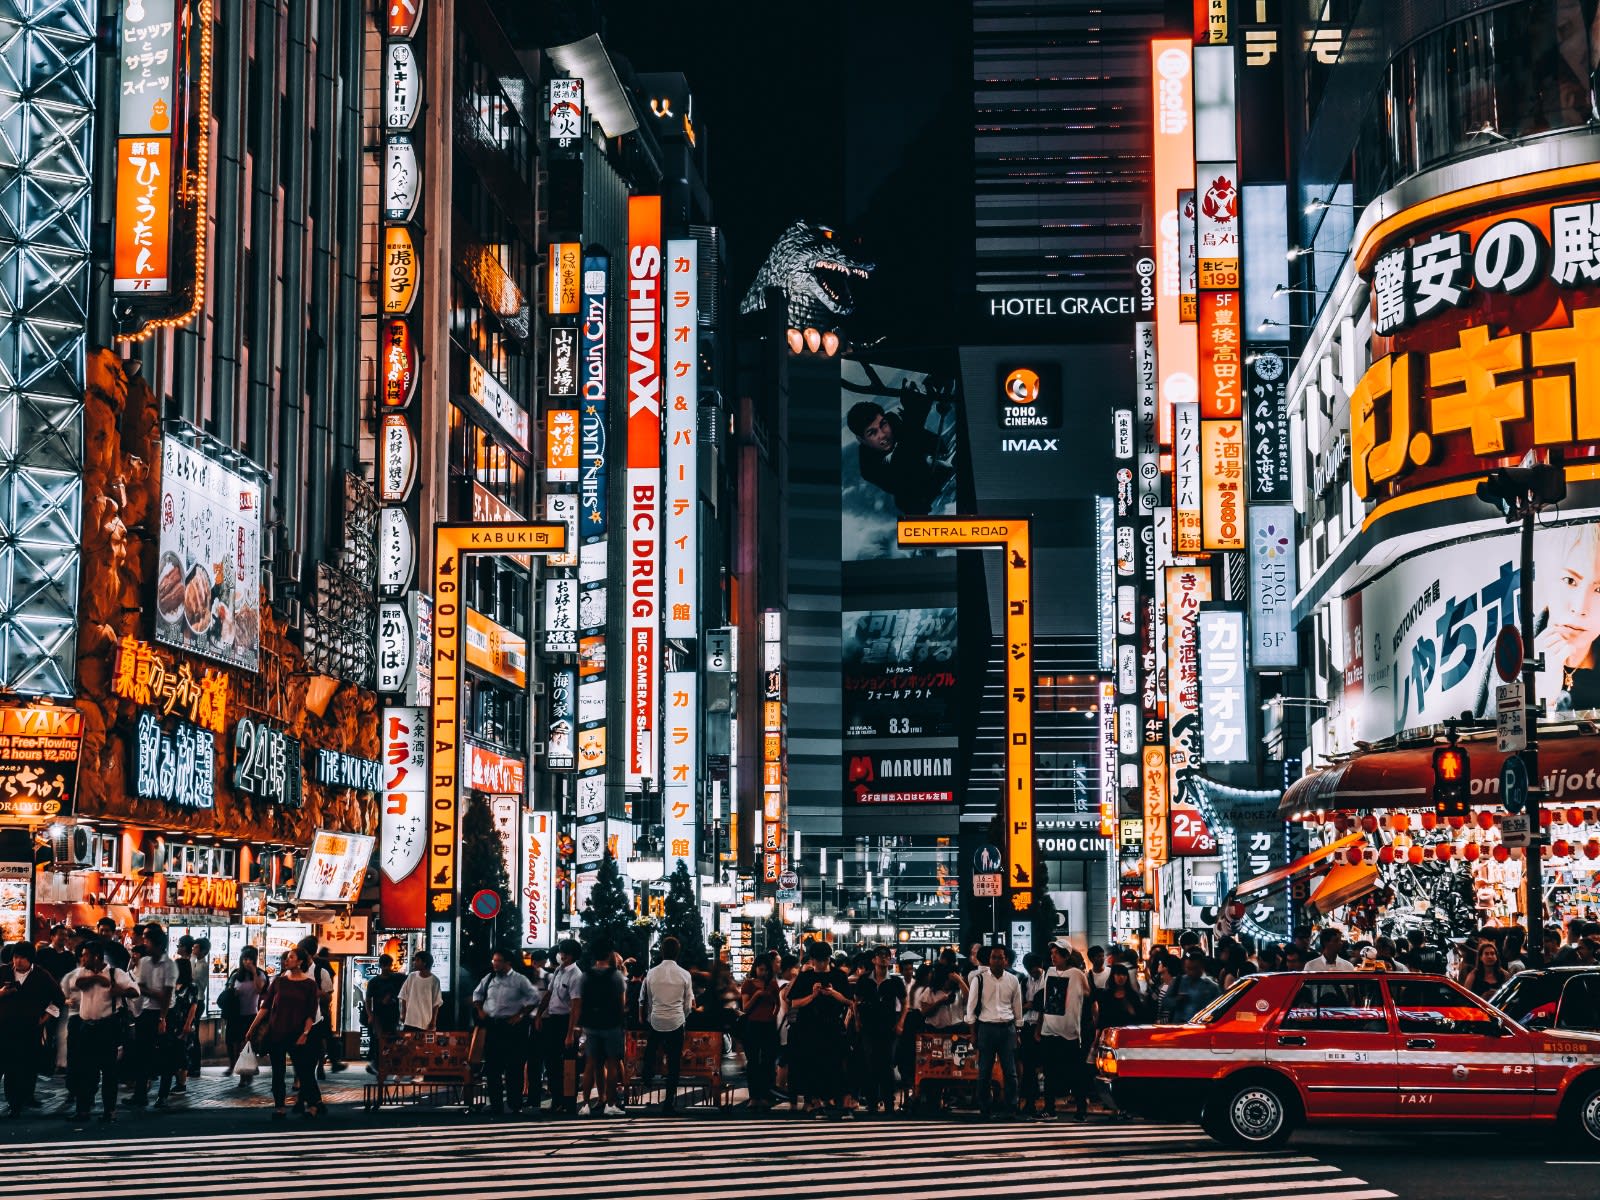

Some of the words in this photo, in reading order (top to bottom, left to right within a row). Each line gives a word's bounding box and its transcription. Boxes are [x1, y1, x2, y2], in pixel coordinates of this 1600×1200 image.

[391, 26, 409, 34] 7F
[125, 49, 169, 70] サラダ
[123, 76, 170, 95] スイーツ
[389, 113, 410, 126] 6F
[131, 142, 160, 155] 新宿
[559, 138, 572, 148] 8F
[128, 156, 162, 275] ひょうたん
[391, 209, 405, 218] 5F
[134, 279, 152, 291] 7F
[389, 250, 412, 293] 虎の子
[1136, 257, 1155, 311] Booth
[1208, 272, 1237, 286] 199
[386, 300, 403, 310] 4F
[991, 298, 1056, 315] HOTEL
[1060, 297, 1135, 315] GRACE
[1216, 294, 1232, 307] 5F
[629, 245, 661, 419] SHIDAX
[1142, 328, 1155, 391] ネットカフェ
[1211, 309, 1239, 416] 豊後高田どり
[472, 366, 482, 397] 3F
[1004, 406, 1036, 417] TOHO
[1004, 416, 1048, 426] CINEMAS
[1002, 439, 1058, 452] IMAX
[1119, 419, 1129, 454] 東京ビル
[1253, 383, 1275, 493] かんかん商店
[388, 428, 403, 491] お好み焼き
[582, 416, 599, 509] SHINJUKU
[1144, 466, 1155, 475] 8F
[1179, 411, 1193, 505] キタノイチバ
[1215, 441, 1242, 480] 酒場
[632, 485, 655, 532] BIC
[1144, 497, 1156, 506] 5F
[1220, 491, 1237, 538] 280
[903, 527, 967, 538] CENTRAL
[971, 526, 1009, 536] ROAD
[388, 526, 402, 581] とらそば
[384, 585, 399, 595] 1F
[632, 540, 654, 618] DRUG
[1261, 564, 1274, 615] STAGE
[1274, 564, 1287, 605] IDOL
[382, 610, 401, 619] 新宿
[555, 581, 571, 629] お好み焼
[381, 619, 402, 669] かっぱ
[637, 631, 648, 653] BIC
[1262, 632, 1287, 648] 5F
[383, 675, 399, 686] B1
[435, 581, 456, 754] GODZILLA
[553, 672, 569, 718] 海の家
[636, 656, 648, 708] CAMERA
[1207, 617, 1242, 756] カラオケ
[15, 710, 81, 736] YAKI
[889, 718, 910, 734] 8.3
[1009, 599, 1028, 835] ゴジラロード
[1145, 719, 1163, 730] 4F
[11, 737, 79, 751] Free-Flowing
[411, 711, 425, 768] 大衆酒場
[1145, 731, 1163, 742] 3F
[2, 750, 10, 760] 2
[11, 749, 42, 760] hours
[138, 711, 215, 808] 飲み放題
[319, 748, 339, 784] THE
[386, 716, 410, 816] トラノコ
[880, 758, 952, 778] MARUHAN
[671, 690, 691, 857] カラオケ館
[44, 802, 58, 811] 2F
[434, 775, 453, 857] ROAD
[1037, 838, 1077, 851] TOHO
[1250, 832, 1275, 923] カラケ
[181, 877, 238, 909] カラオケBOX
[523, 882, 542, 946] Garden
[326, 931, 365, 941] トラノコ
[1354, 1052, 1368, 1061] 31
[1400, 1094, 1434, 1104] TAXI
